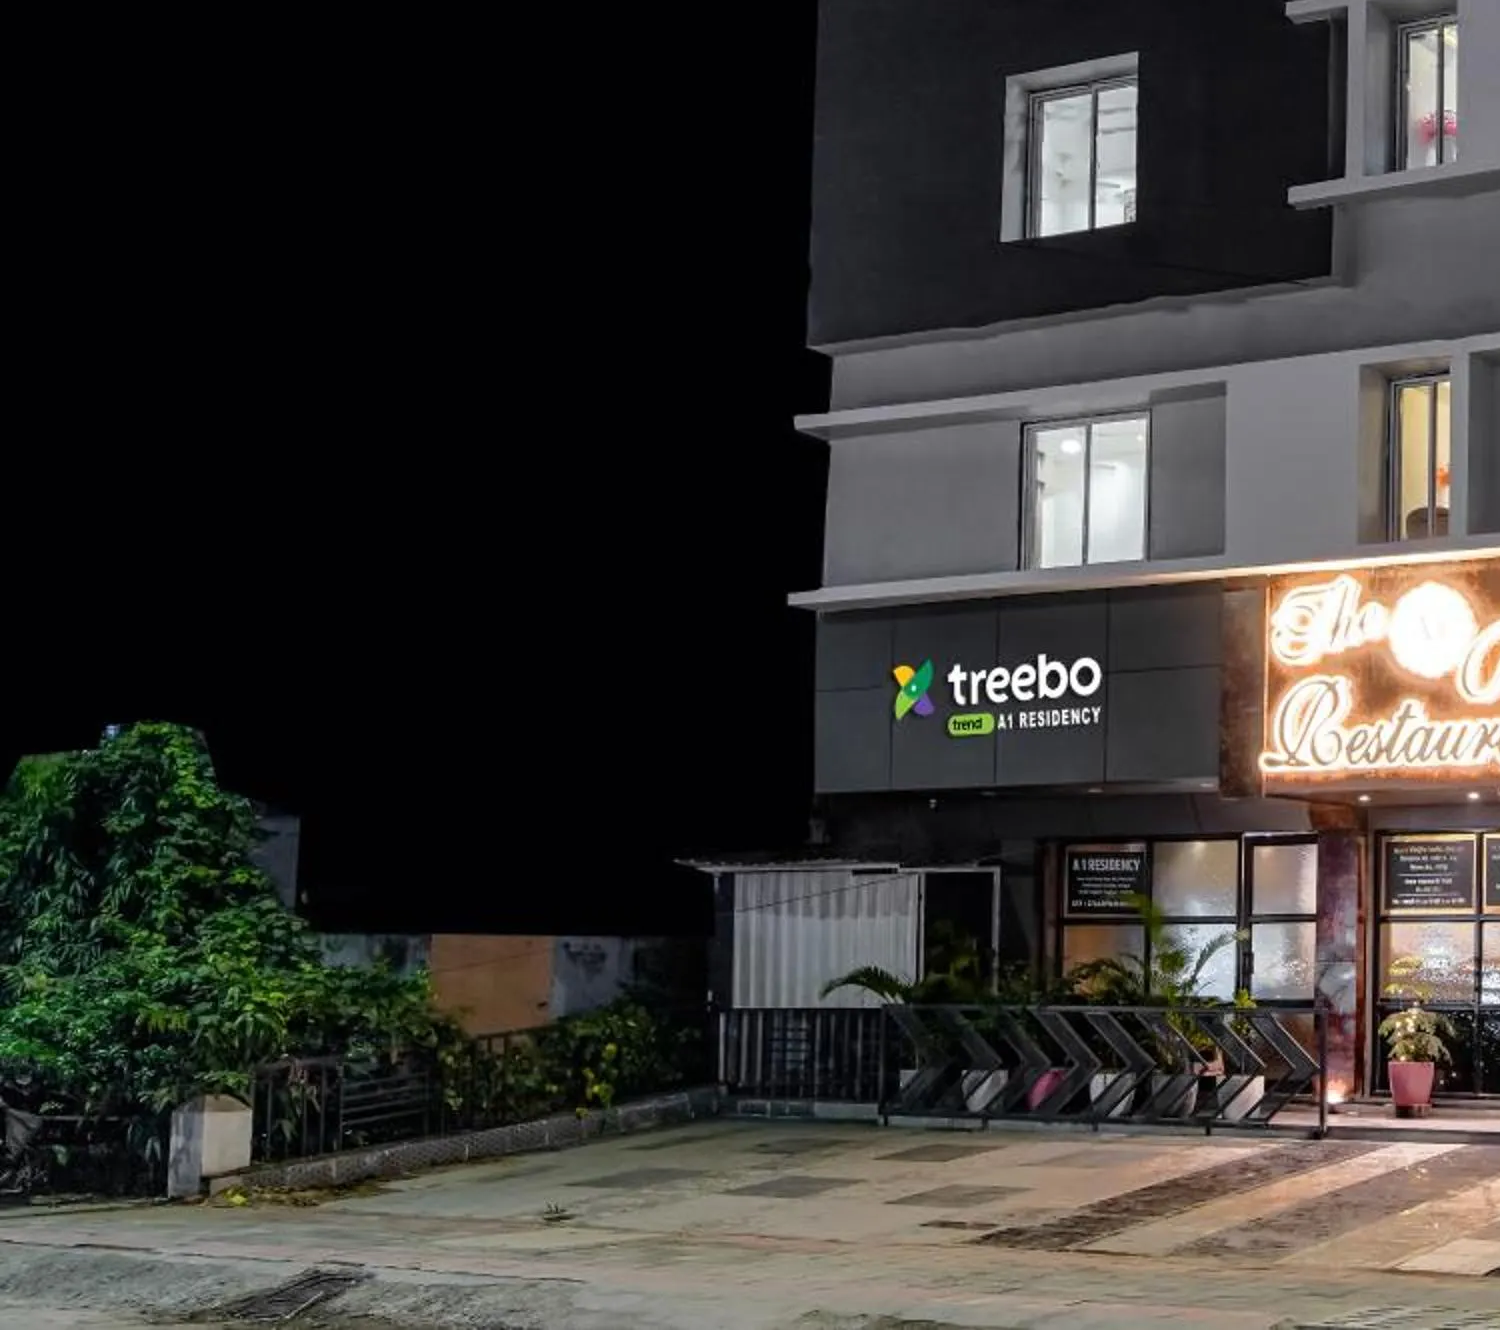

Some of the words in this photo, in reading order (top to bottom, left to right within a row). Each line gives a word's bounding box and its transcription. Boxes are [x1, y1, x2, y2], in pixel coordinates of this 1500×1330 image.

[1273, 576, 1388, 664] The
[947, 654, 1102, 705] treebo
[952, 718, 984, 731] trend
[997, 713, 1014, 729] A1
[1019, 707, 1101, 728] RESIDENCY
